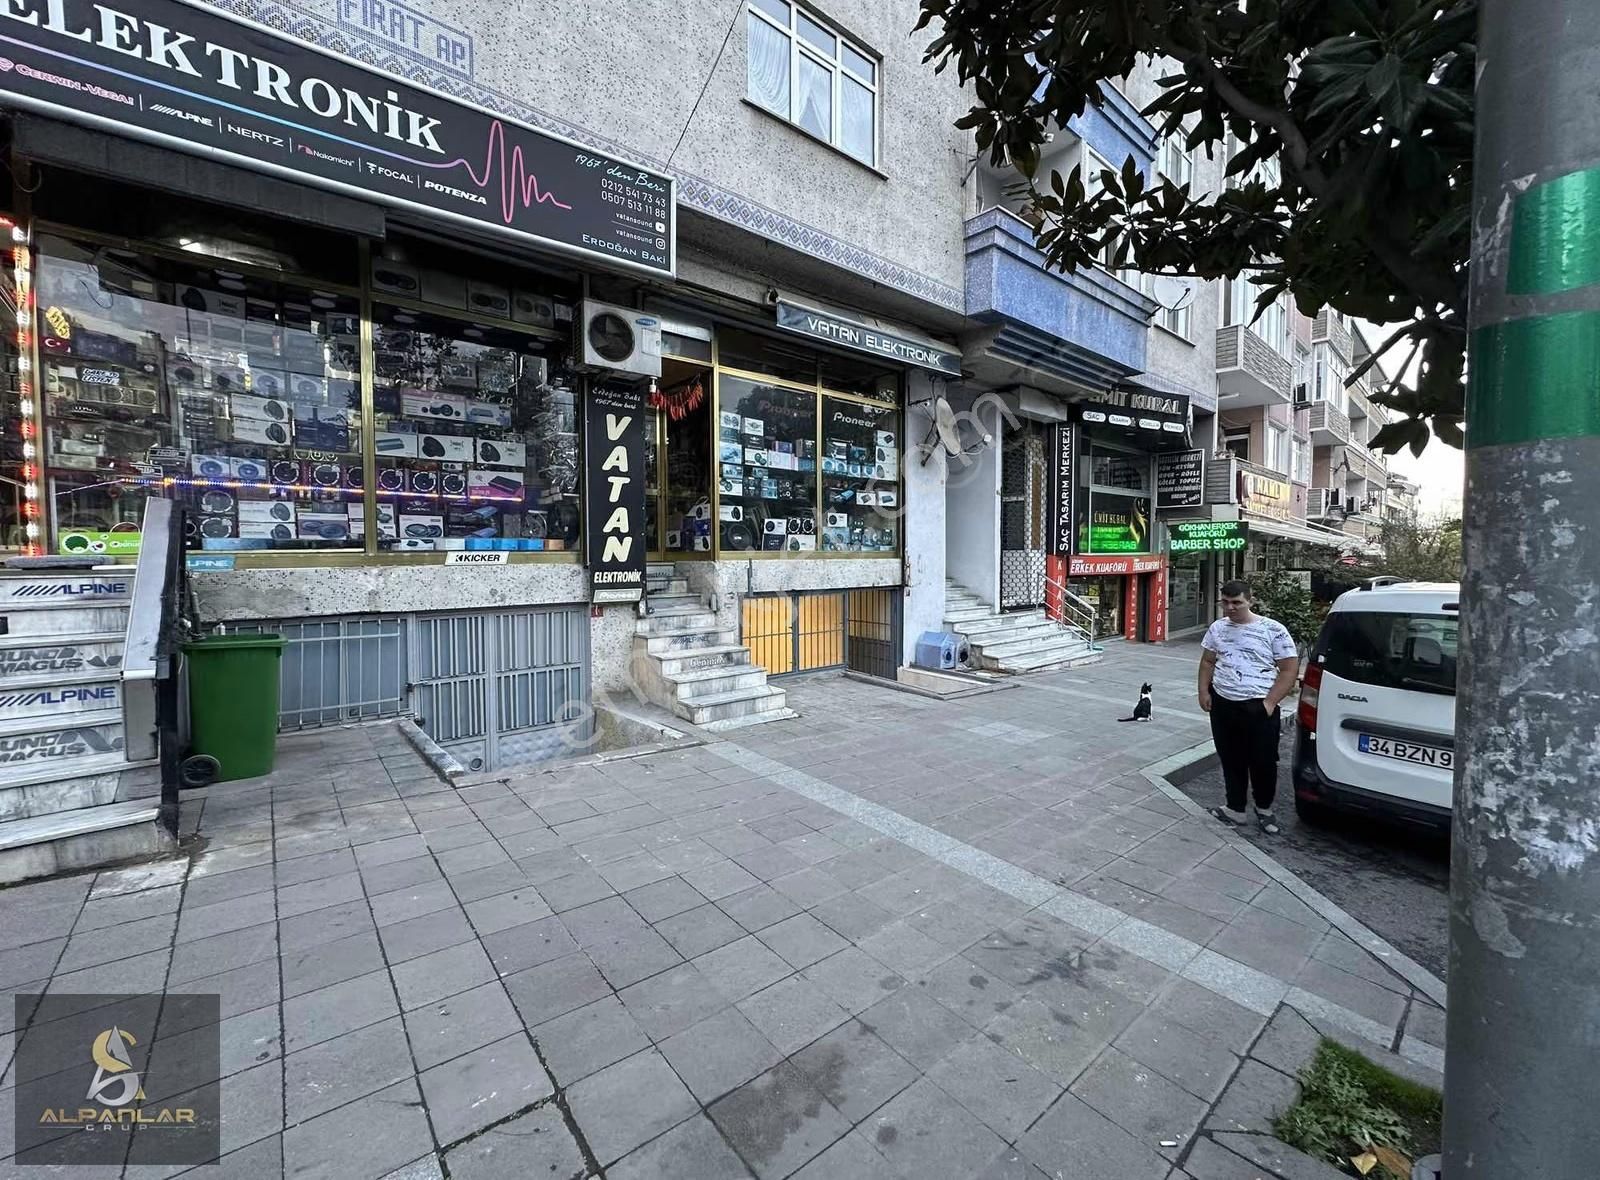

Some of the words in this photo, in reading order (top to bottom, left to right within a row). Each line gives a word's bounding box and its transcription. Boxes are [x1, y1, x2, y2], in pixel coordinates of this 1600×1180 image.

[227, 124, 285, 147] HERTZ
[312, 150, 355, 167] Nakamichi
[377, 167, 414, 184] FOCAL
[635, 172, 666, 192] Beri
[424, 180, 487, 205] POTENZA
[601, 178, 624, 194] 0212
[625, 186, 641, 199] 541
[643, 192, 653, 203] 73
[655, 197, 666, 208] 43
[601, 190, 625, 206] 0507
[627, 199, 642, 212] 513
[645, 204, 653, 216] 11
[655, 208, 666, 219] 88
[615, 212, 653, 228] vatansound
[615, 229, 653, 245] vatansound
[807, 316, 859, 344] VATAN
[1130, 393, 1182, 415] KURAL
[833, 411, 876, 429] Pioneer
[1060, 427, 1070, 476] MERKEZİ
[601, 412, 632, 563] VATAN
[1060, 528, 1071, 551] SAÇ
[1170, 538, 1211, 550] BARBER
[1213, 537, 1245, 549] SHOP
[187, 558, 231, 568] LPINE
[462, 553, 501, 563] KICKER
[593, 568, 642, 584] ELEKTRONİK
[1070, 562, 1096, 574] ERKEK
[49, 582, 126, 596] ALPINE
[25, 686, 116, 706] ALPINE
[1337, 693, 1369, 703] DACIA
[1369, 738, 1391, 755] 34
[1393, 744, 1436, 764] BZN
